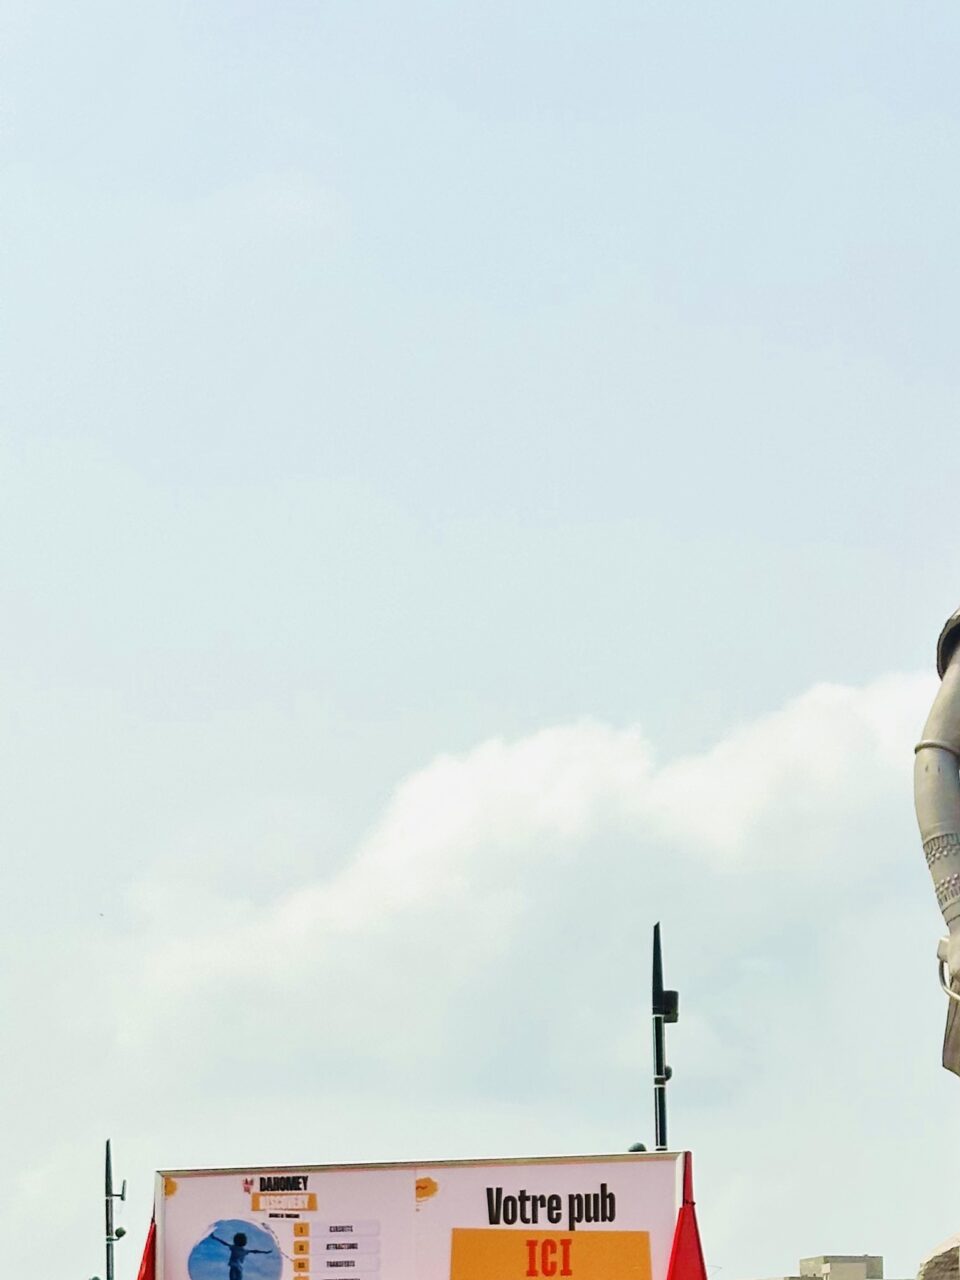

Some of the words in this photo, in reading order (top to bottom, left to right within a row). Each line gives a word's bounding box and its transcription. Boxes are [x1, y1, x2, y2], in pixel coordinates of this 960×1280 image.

[259, 1175, 309, 1192] DAHOMEY
[486, 1186, 562, 1225] Votre
[568, 1183, 616, 1231] pub
[526, 1238, 573, 1277] ICI
